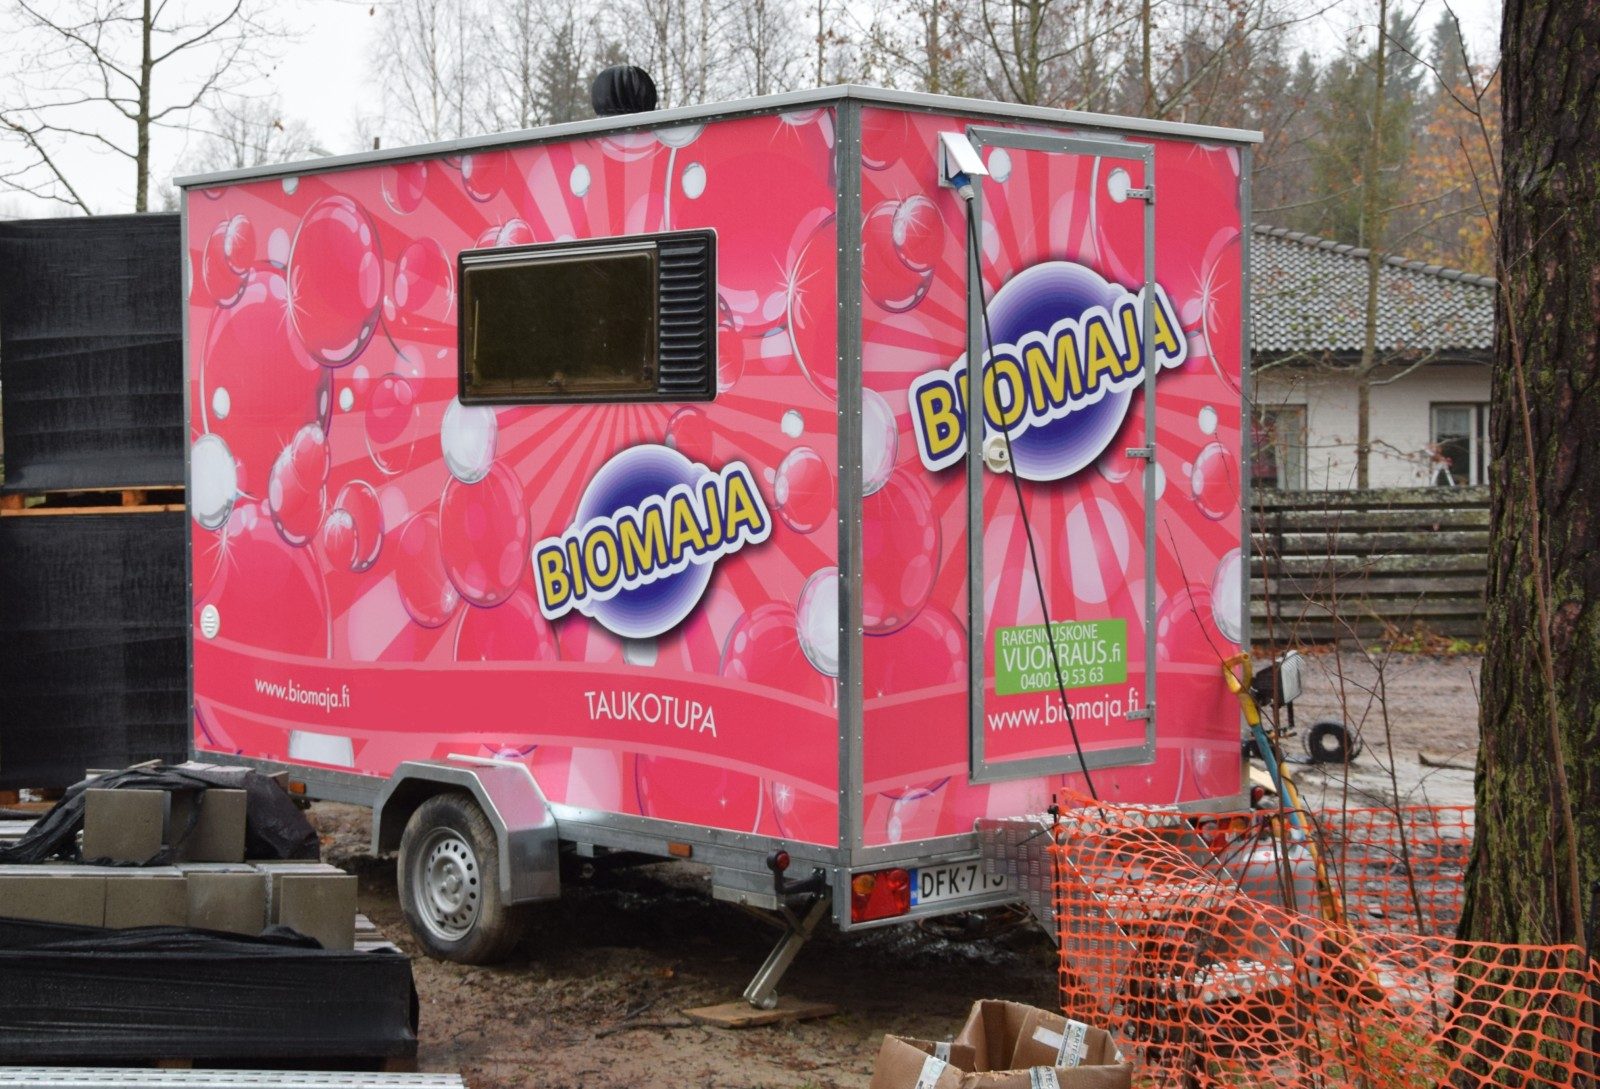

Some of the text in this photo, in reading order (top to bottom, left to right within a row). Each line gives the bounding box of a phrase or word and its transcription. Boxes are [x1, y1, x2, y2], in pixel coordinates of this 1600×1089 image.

[913, 293, 1183, 463] BOMAJA
[536, 468, 766, 612] BIOMAJA
[254, 678, 350, 713] www.biomaja.fi
[1020, 672, 1051, 690] 0400
[1072, 668, 1086, 685] 53
[1089, 667, 1104, 683] 63
[584, 690, 717, 737] TAUKOTUPA
[987, 687, 1139, 730] www.biomaja.fi
